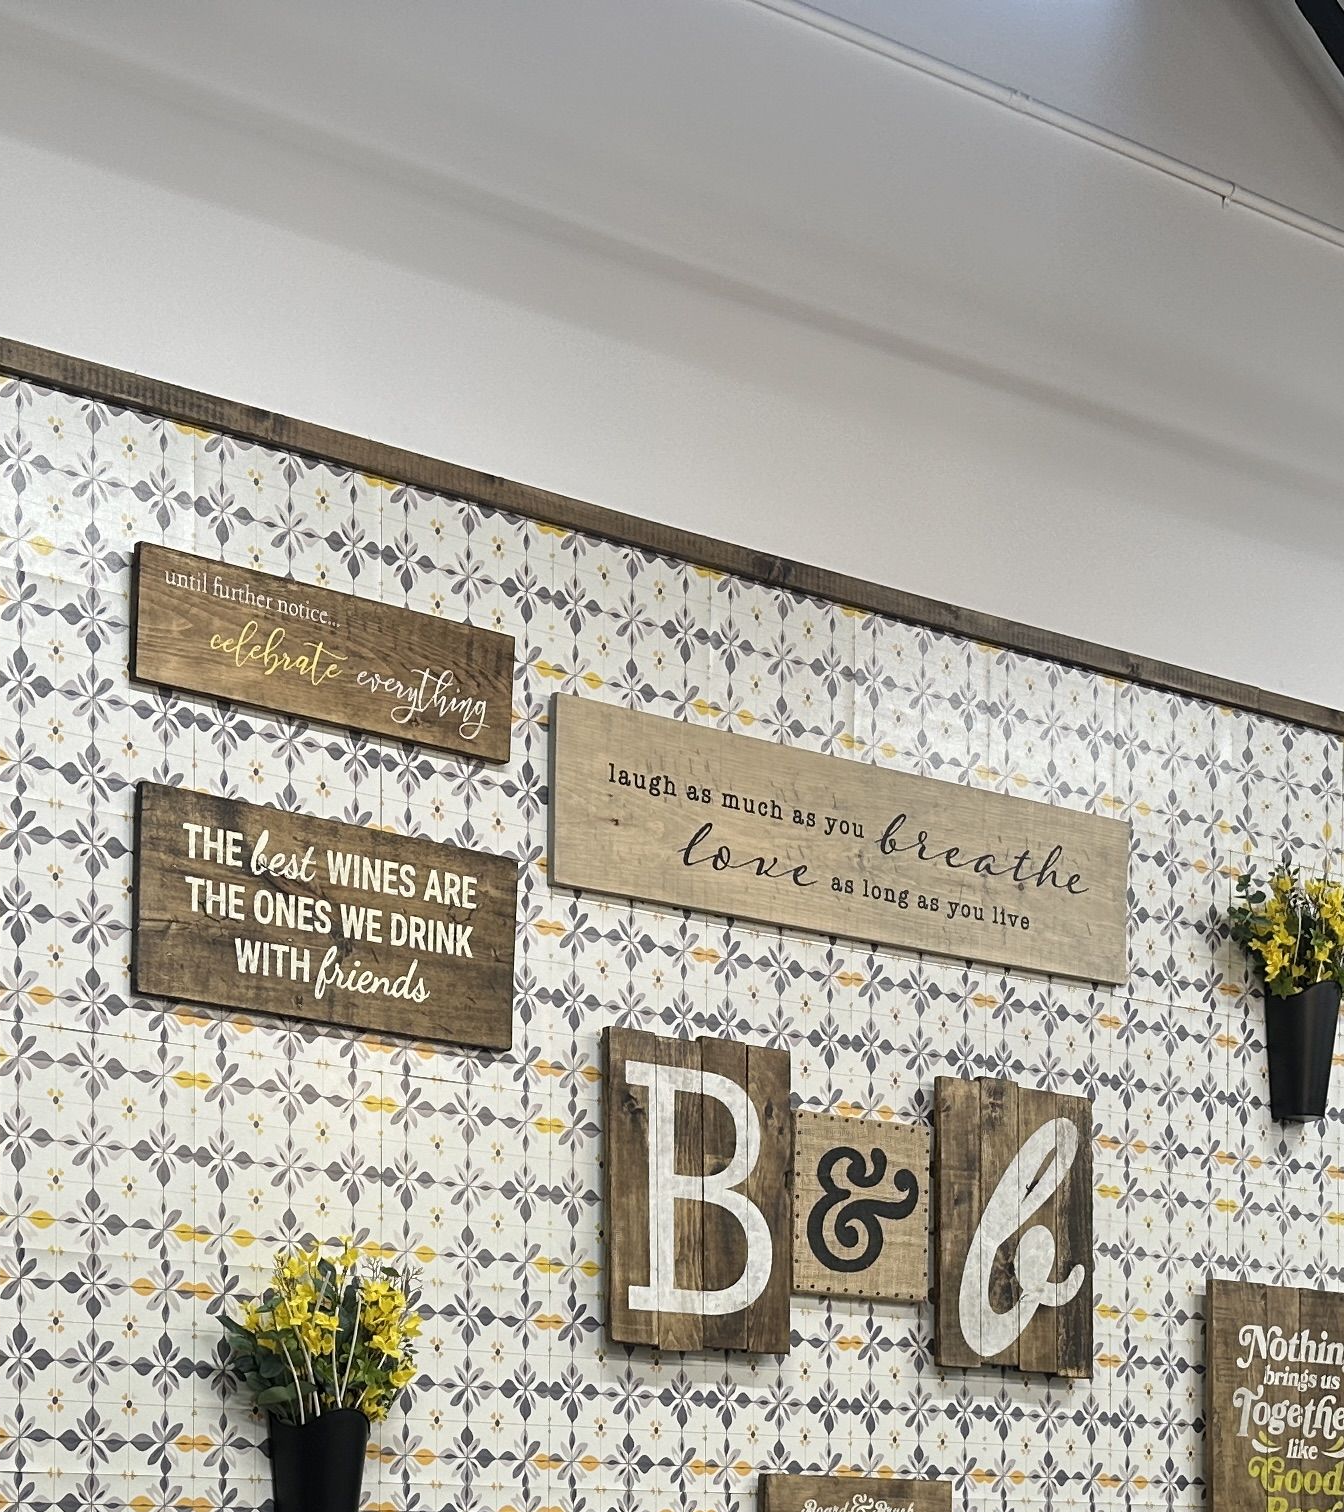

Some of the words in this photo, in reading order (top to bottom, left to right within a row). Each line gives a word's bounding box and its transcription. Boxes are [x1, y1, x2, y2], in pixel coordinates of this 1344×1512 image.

[164, 567, 208, 595] until
[212, 576, 273, 611] further
[210, 620, 349, 686] celebrate
[356, 667, 491, 740] everything
[182, 822, 244, 869] THE
[248, 829, 317, 883] best
[326, 849, 417, 899] WINES
[423, 869, 478, 910] ARE
[607, 762, 678, 798] laugh
[685, 781, 713, 805] as
[721, 788, 784, 822] much
[791, 806, 818, 830] as
[825, 814, 866, 840] you
[874, 813, 1090, 896] breathe
[184, 875, 246, 921] THE
[253, 888, 333, 935] ONES
[339, 903, 383, 944] WE
[390, 911, 475, 959] DRINK
[677, 822, 820, 888] love
[830, 874, 855, 895] as
[861, 877, 910, 911] long
[916, 891, 940, 912] as
[946, 898, 986, 923] you
[992, 905, 1031, 931] live
[233, 936, 311, 984] WITH
[314, 945, 431, 1003] friends
[624, 1059, 774, 1316] B
[806, 1145, 919, 1273] &
[1263, 1364, 1318, 1392] brings
[1320, 1373, 1341, 1391] us
[1286, 1437, 1319, 1461] like
